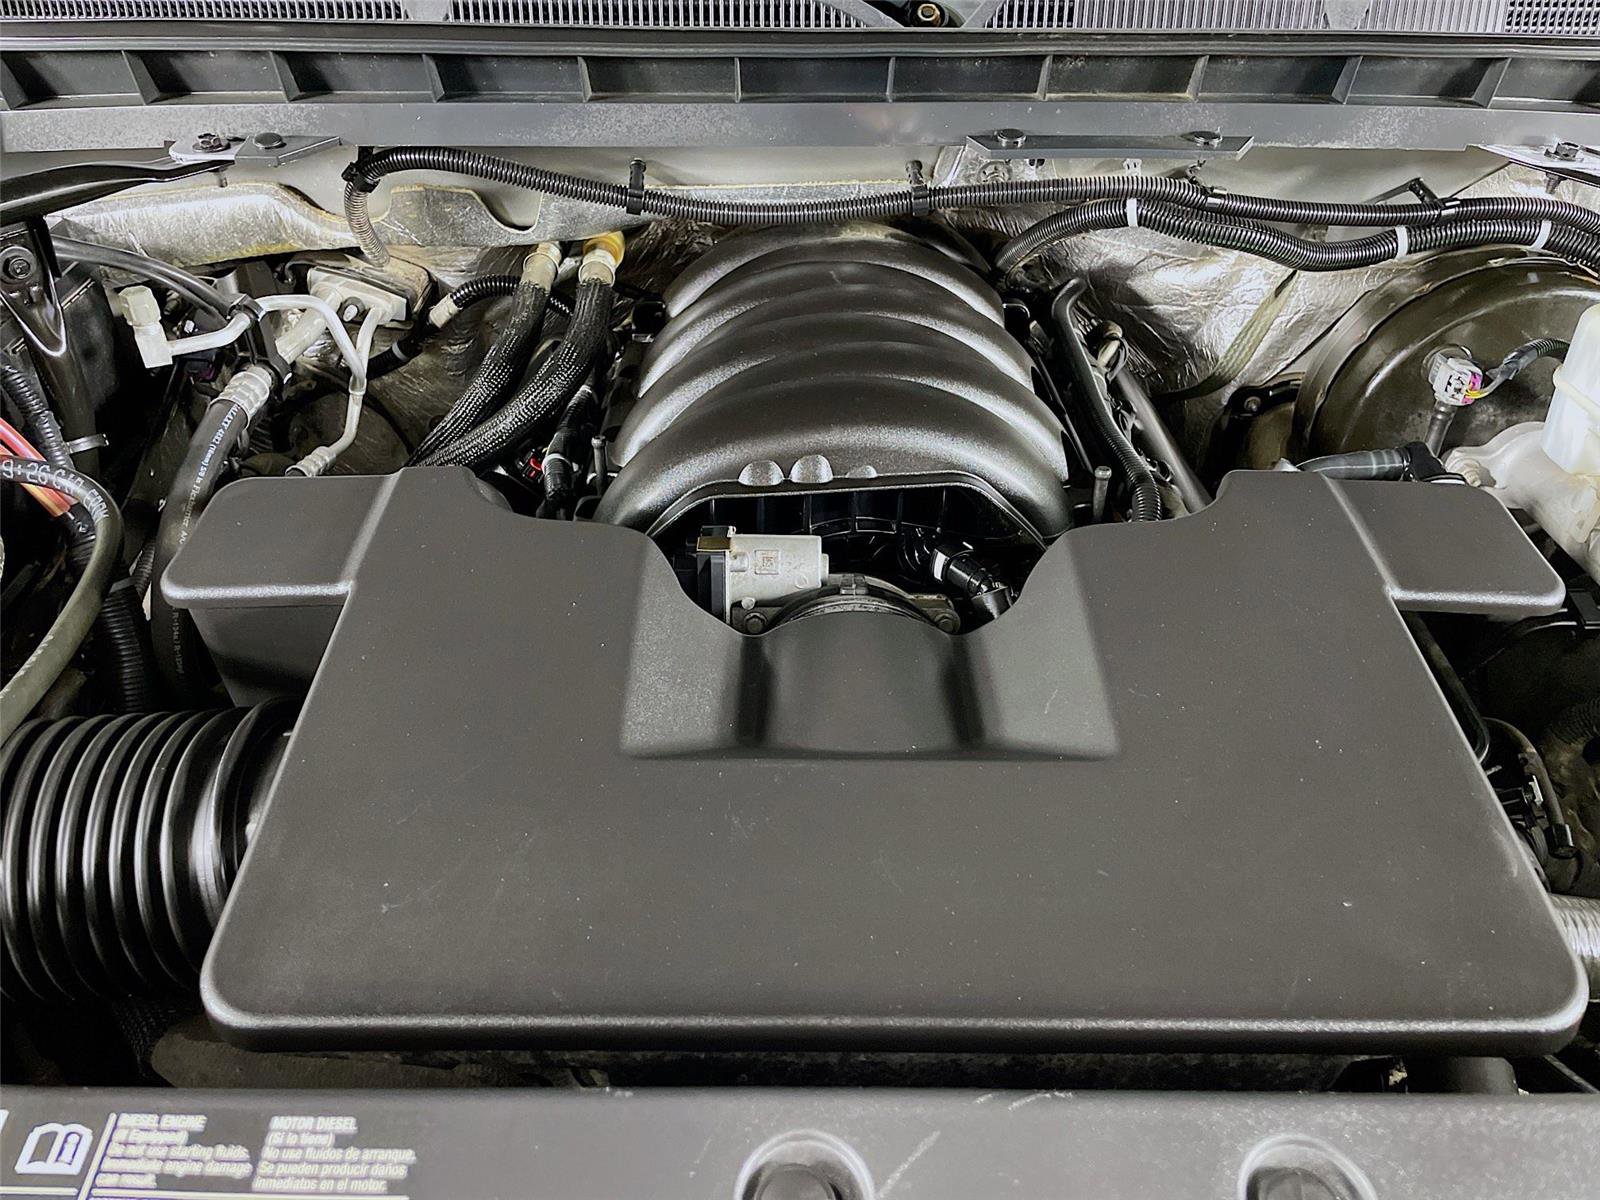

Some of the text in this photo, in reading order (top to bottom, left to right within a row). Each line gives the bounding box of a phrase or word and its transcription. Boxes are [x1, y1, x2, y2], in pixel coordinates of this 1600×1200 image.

[117, 1113, 207, 1130] DIESEL ENGINE
[269, 1116, 358, 1132] MOTOR DIESEL
[266, 1131, 335, 1148] (Si lo tiene)
[146, 1146, 168, 1159] use
[168, 1145, 213, 1162] starting
[214, 1145, 250, 1161] fluids.
[262, 1147, 280, 1160] No
[304, 1147, 343, 1162] fluidos
[345, 1146, 360, 1162] de
[361, 1149, 416, 1165] arranque.
[163, 1160, 203, 1177] engine
[204, 1160, 252, 1179] damage
[257, 1162, 274, 1176] Se
[275, 1163, 321, 1179] pueden
[321, 1163, 368, 1179] producir
[319, 1179, 334, 1192] en
[336, 1177, 349, 1192] el
[351, 1179, 388, 1193] motor.
